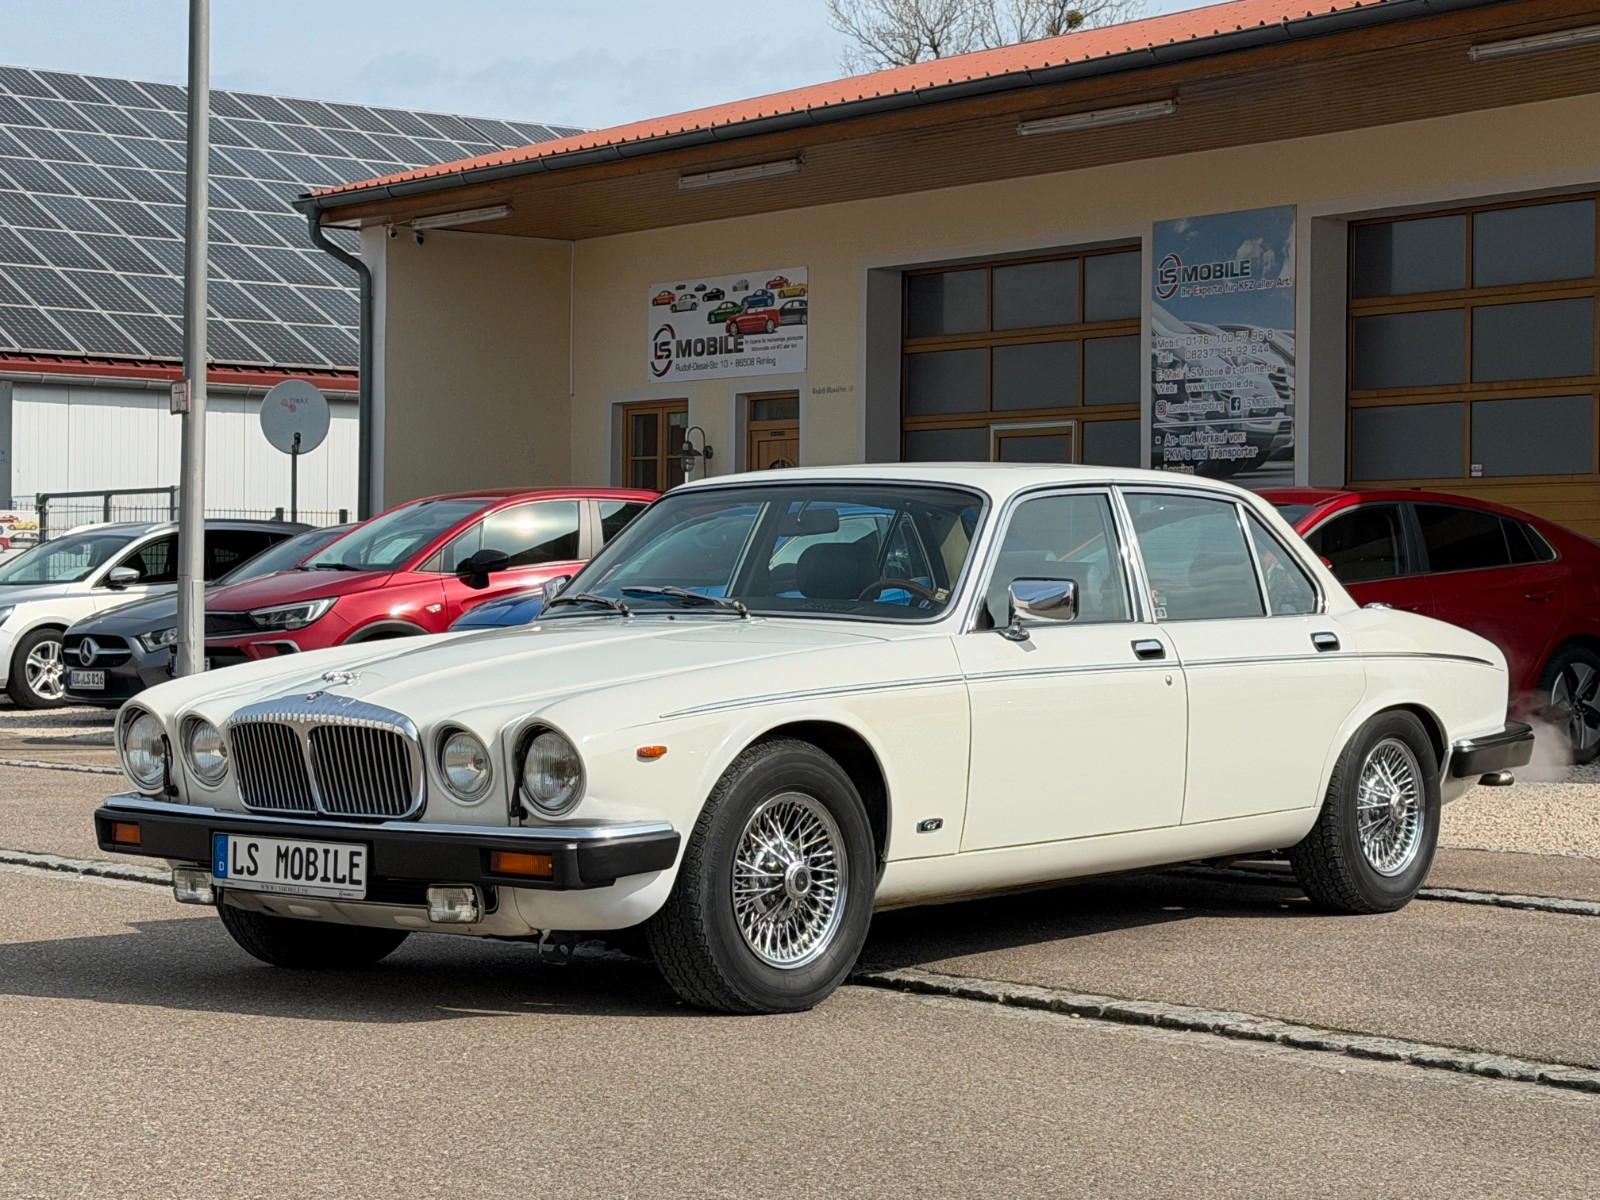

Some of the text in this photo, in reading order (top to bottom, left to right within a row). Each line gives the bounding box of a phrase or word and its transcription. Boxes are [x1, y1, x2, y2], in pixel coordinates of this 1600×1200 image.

[1160, 260, 1250, 285] LS MOBILE
[1239, 281, 1254, 292] KFZ
[654, 341, 672, 360] LS
[675, 334, 745, 359] MOBILE
[1186, 335, 1209, 346] 0176
[1216, 333, 1233, 344] 100
[1236, 345, 1248, 356] 92
[1251, 343, 1269, 354] 844
[721, 360, 728, 369] 10
[1180, 432, 1195, 445] und
[1196, 430, 1228, 445] Verkauf
[1192, 447, 1208, 460] und
[1209, 445, 1258, 461] Transporter
[232, 841, 259, 876] LS
[275, 845, 363, 886] MOBILE
